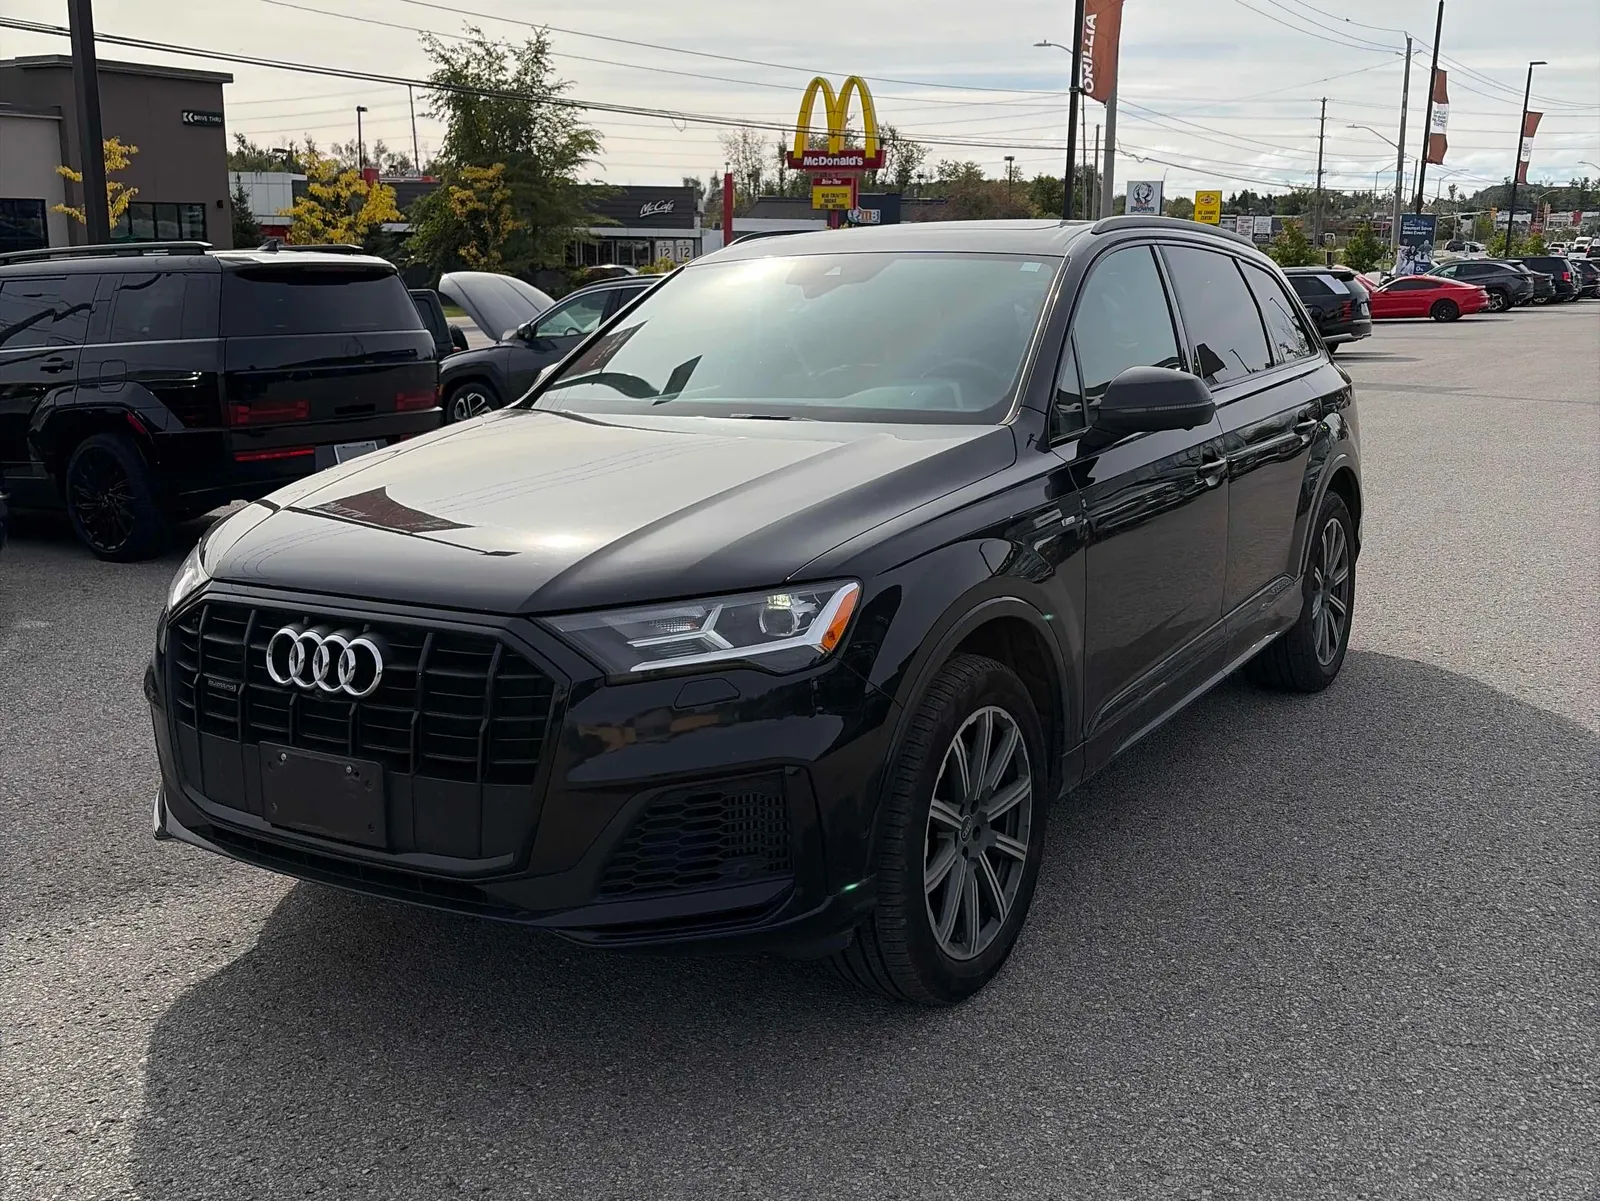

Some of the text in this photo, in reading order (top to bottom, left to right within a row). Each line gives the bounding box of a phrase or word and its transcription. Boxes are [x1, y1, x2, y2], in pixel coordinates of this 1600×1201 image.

[1082, 13, 1097, 93] ORILLIA
[803, 156, 864, 166] McDonald's
[680, 247, 690, 258] 12
